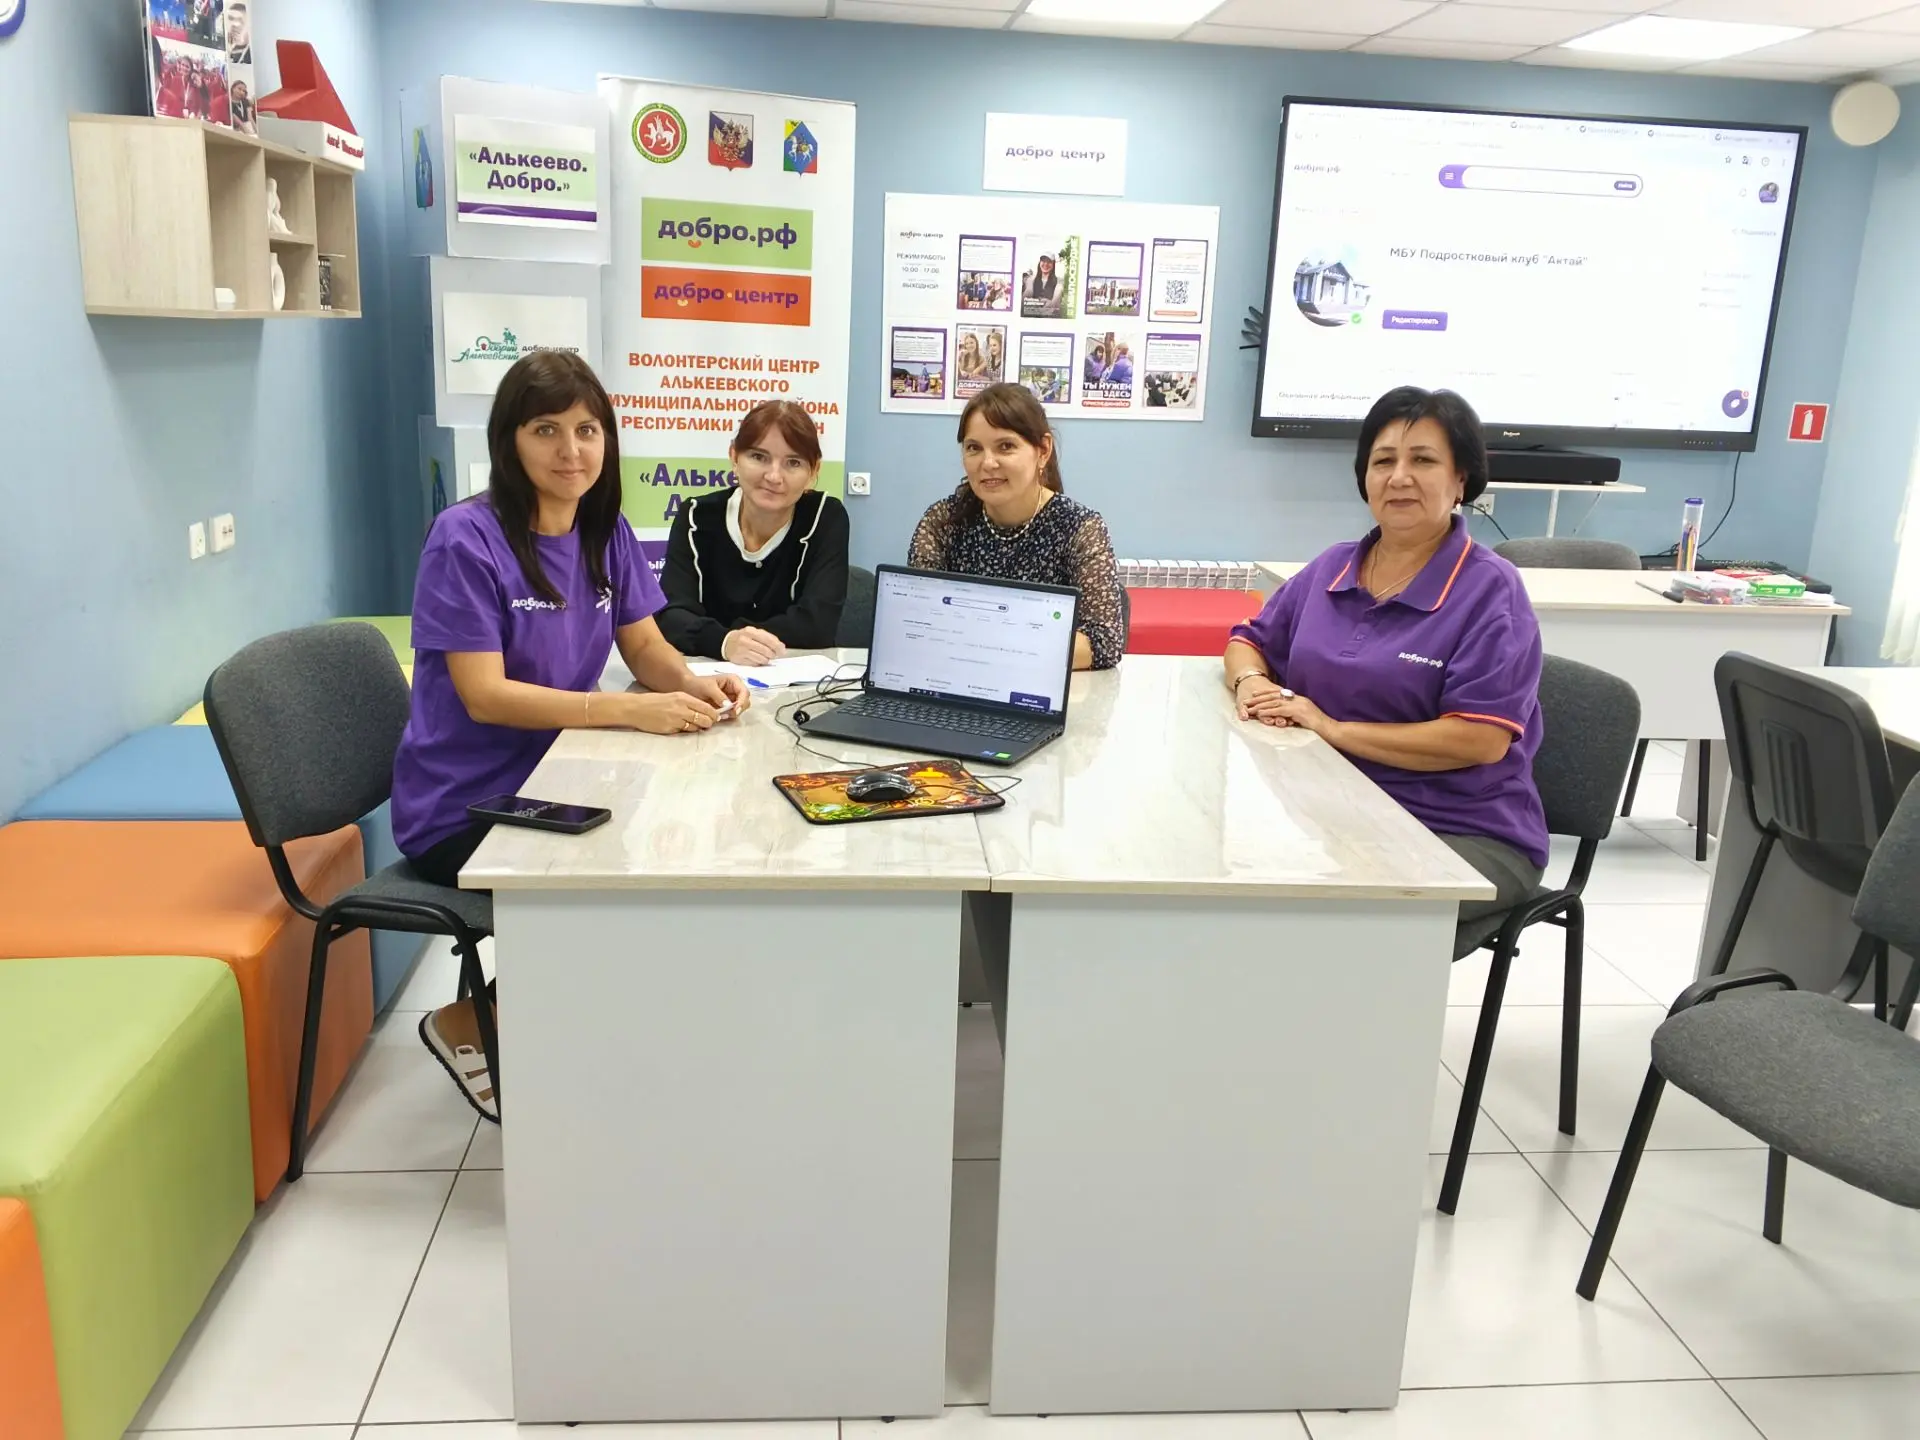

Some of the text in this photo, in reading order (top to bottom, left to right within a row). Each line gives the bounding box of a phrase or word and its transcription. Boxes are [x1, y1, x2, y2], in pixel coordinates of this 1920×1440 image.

[469, 146, 588, 172] «Алькеево.
[487, 170, 570, 192] Добро.»
[658, 217, 797, 249] добро.рф
[1390, 247, 1416, 258] МБУ
[1420, 249, 1508, 263] Подростковый
[1511, 253, 1539, 266] клуб
[628, 352, 820, 374] ВОЛОНТЕРСКИЙ ЦЕНТР
[659, 375, 790, 393] АЛЬКЕЕВСКОГО
[1084, 382, 1132, 391] ТЫ НУЖЕН
[1104, 390, 1131, 398] ЗДЕСЬ
[794, 396, 839, 415] ЙОНА
[621, 415, 733, 432] РЕСПУБЛИКИ
[1398, 652, 1444, 668] добро.рф
